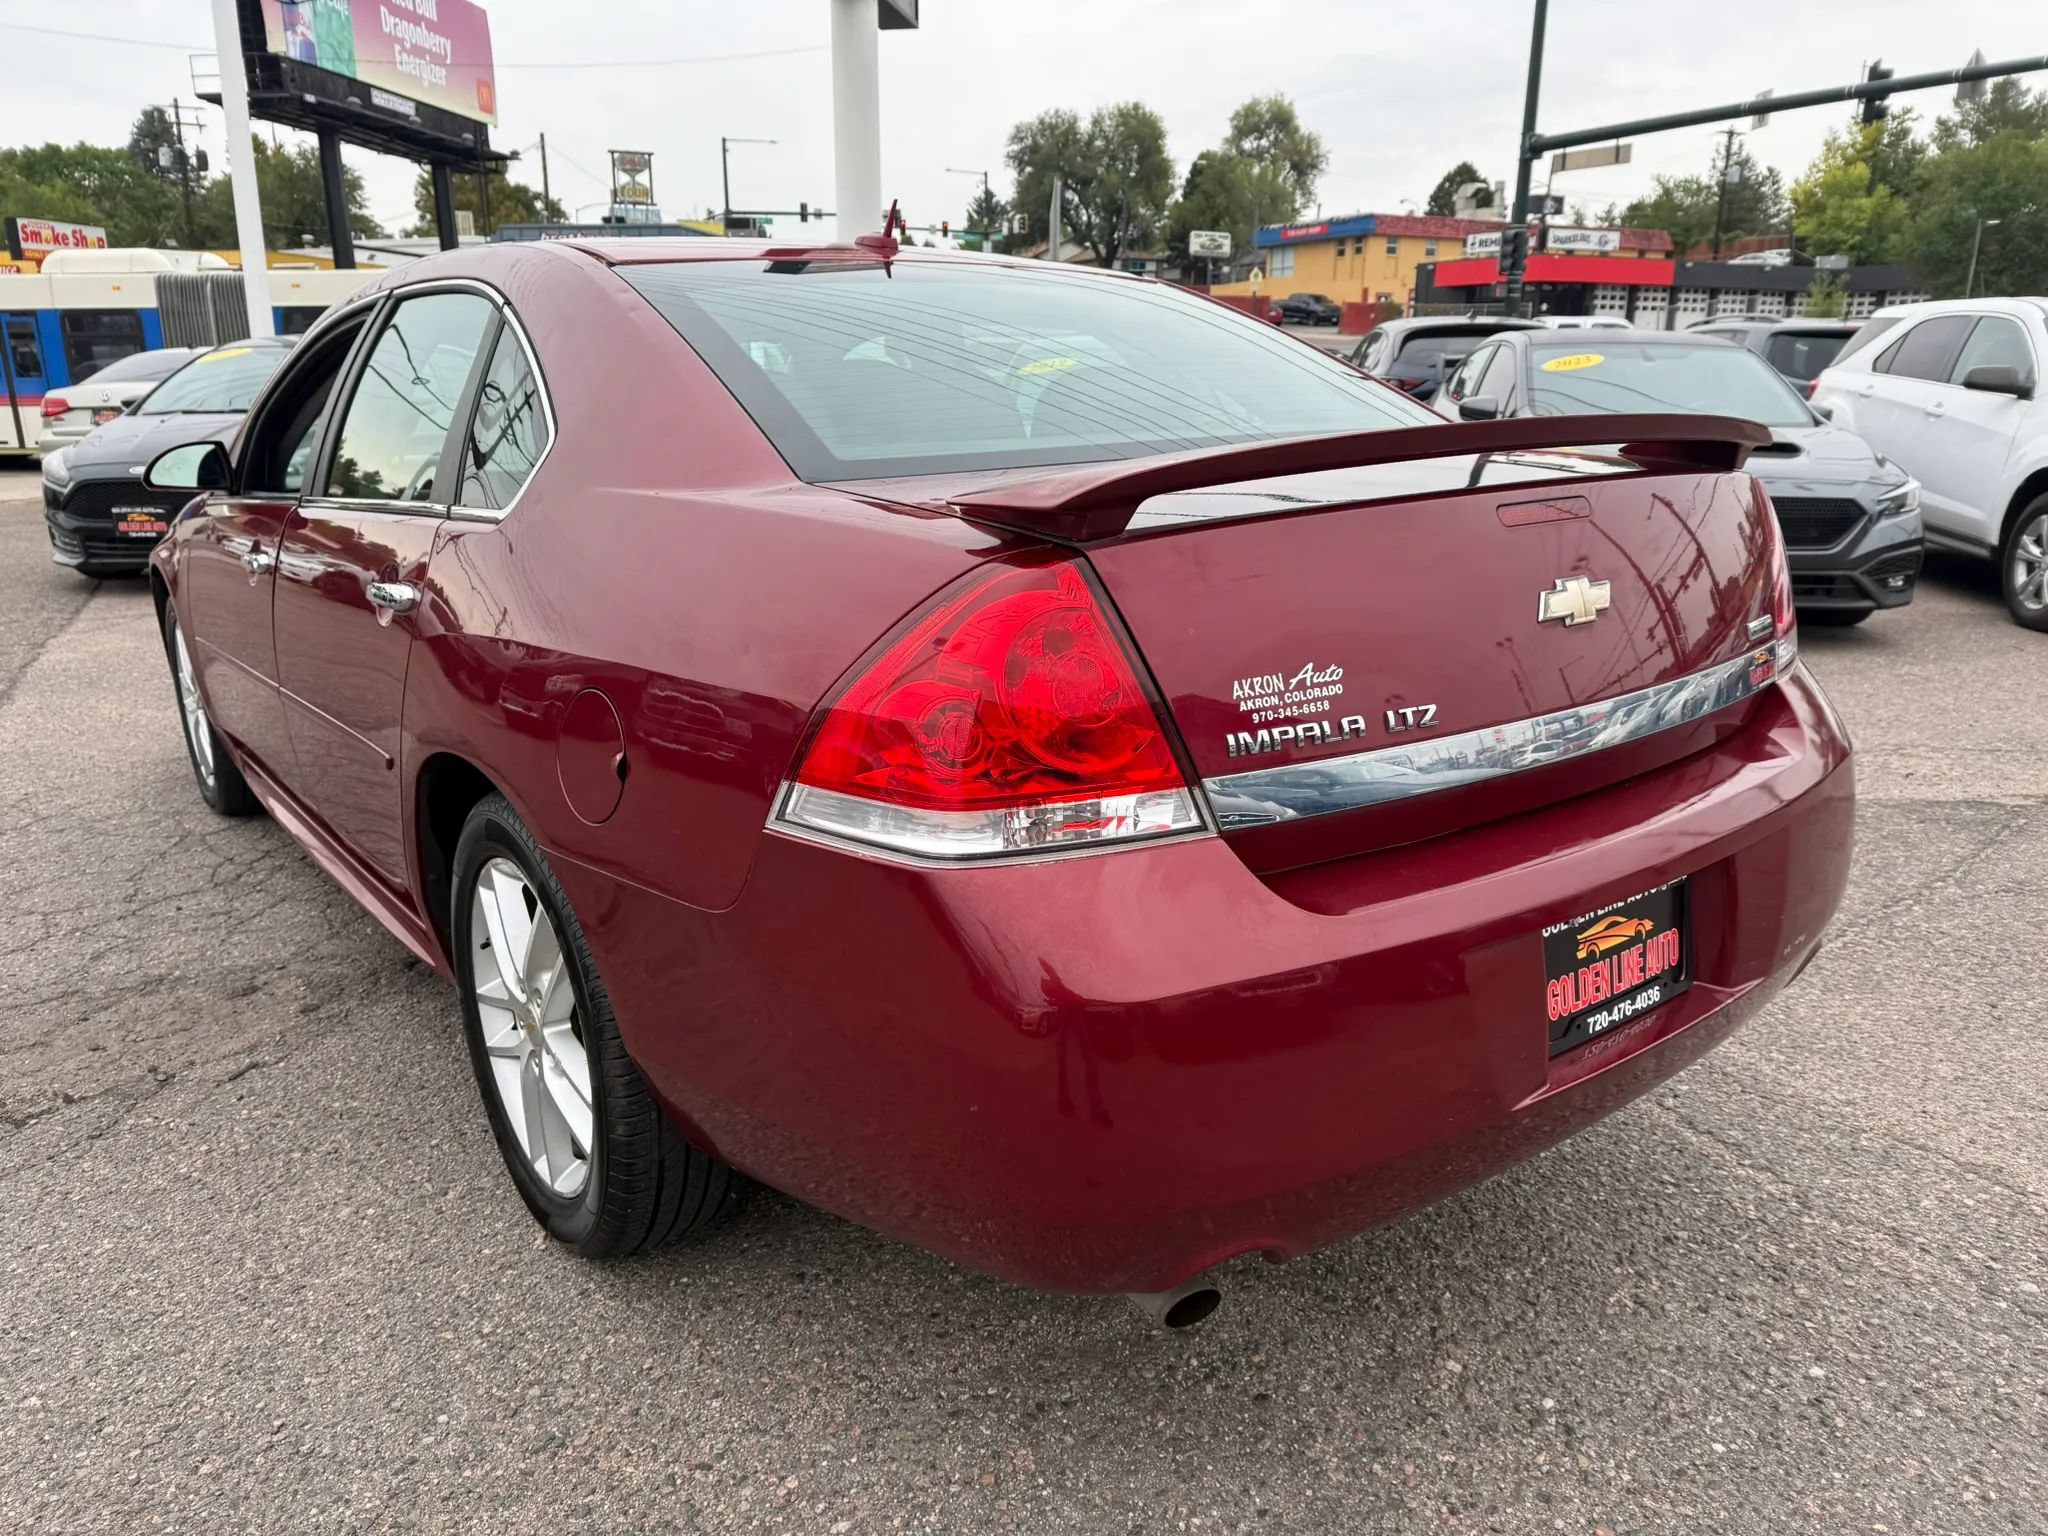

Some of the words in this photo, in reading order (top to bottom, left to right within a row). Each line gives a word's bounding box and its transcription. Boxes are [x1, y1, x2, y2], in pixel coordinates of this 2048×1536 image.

[380, 4, 451, 64] Dragonberry
[394, 43, 446, 87] Energizer
[21, 223, 70, 246] Smoke
[72, 227, 105, 248] Shop
[1232, 673, 1285, 700] AKRON
[1288, 661, 1343, 690] Auto
[1239, 695, 1284, 712] AKRON,
[1284, 683, 1343, 704] COLORADO
[1226, 715, 1367, 758] IMPALA
[1385, 703, 1440, 733] LTZ
[1251, 700, 1330, 724] 970-345-6658
[1547, 958, 1612, 1021] GOLDEN
[1612, 943, 1645, 995] LINE
[1645, 927, 1679, 979] AUTO
[1587, 985, 1661, 1035] 720-476-4036
